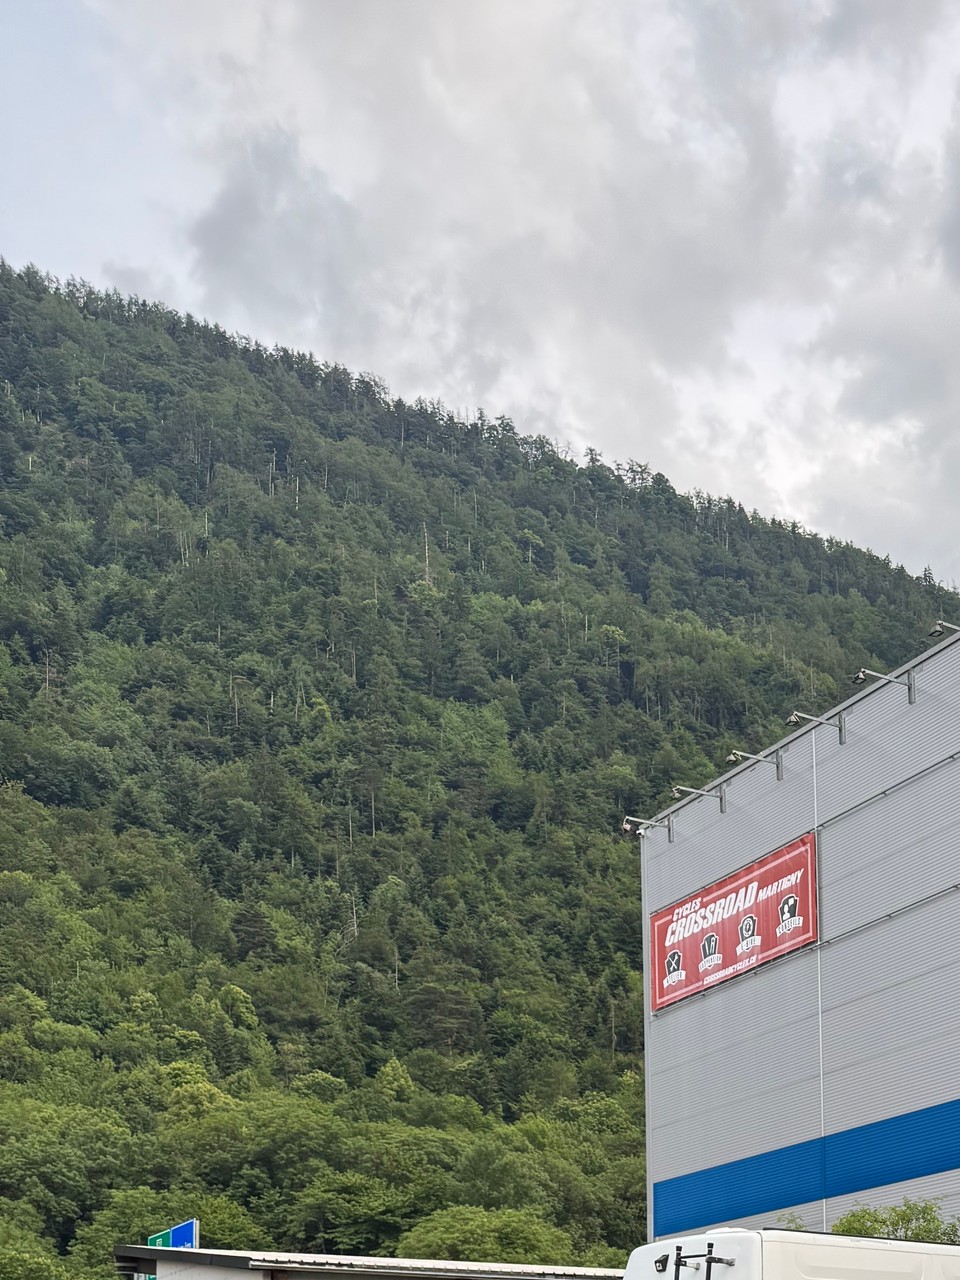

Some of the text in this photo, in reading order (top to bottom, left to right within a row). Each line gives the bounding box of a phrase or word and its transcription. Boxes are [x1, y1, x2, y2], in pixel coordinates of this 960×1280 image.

[665, 868, 804, 947] CROSSROAD MARTIGNY
[673, 897, 702, 921] CYCLES
